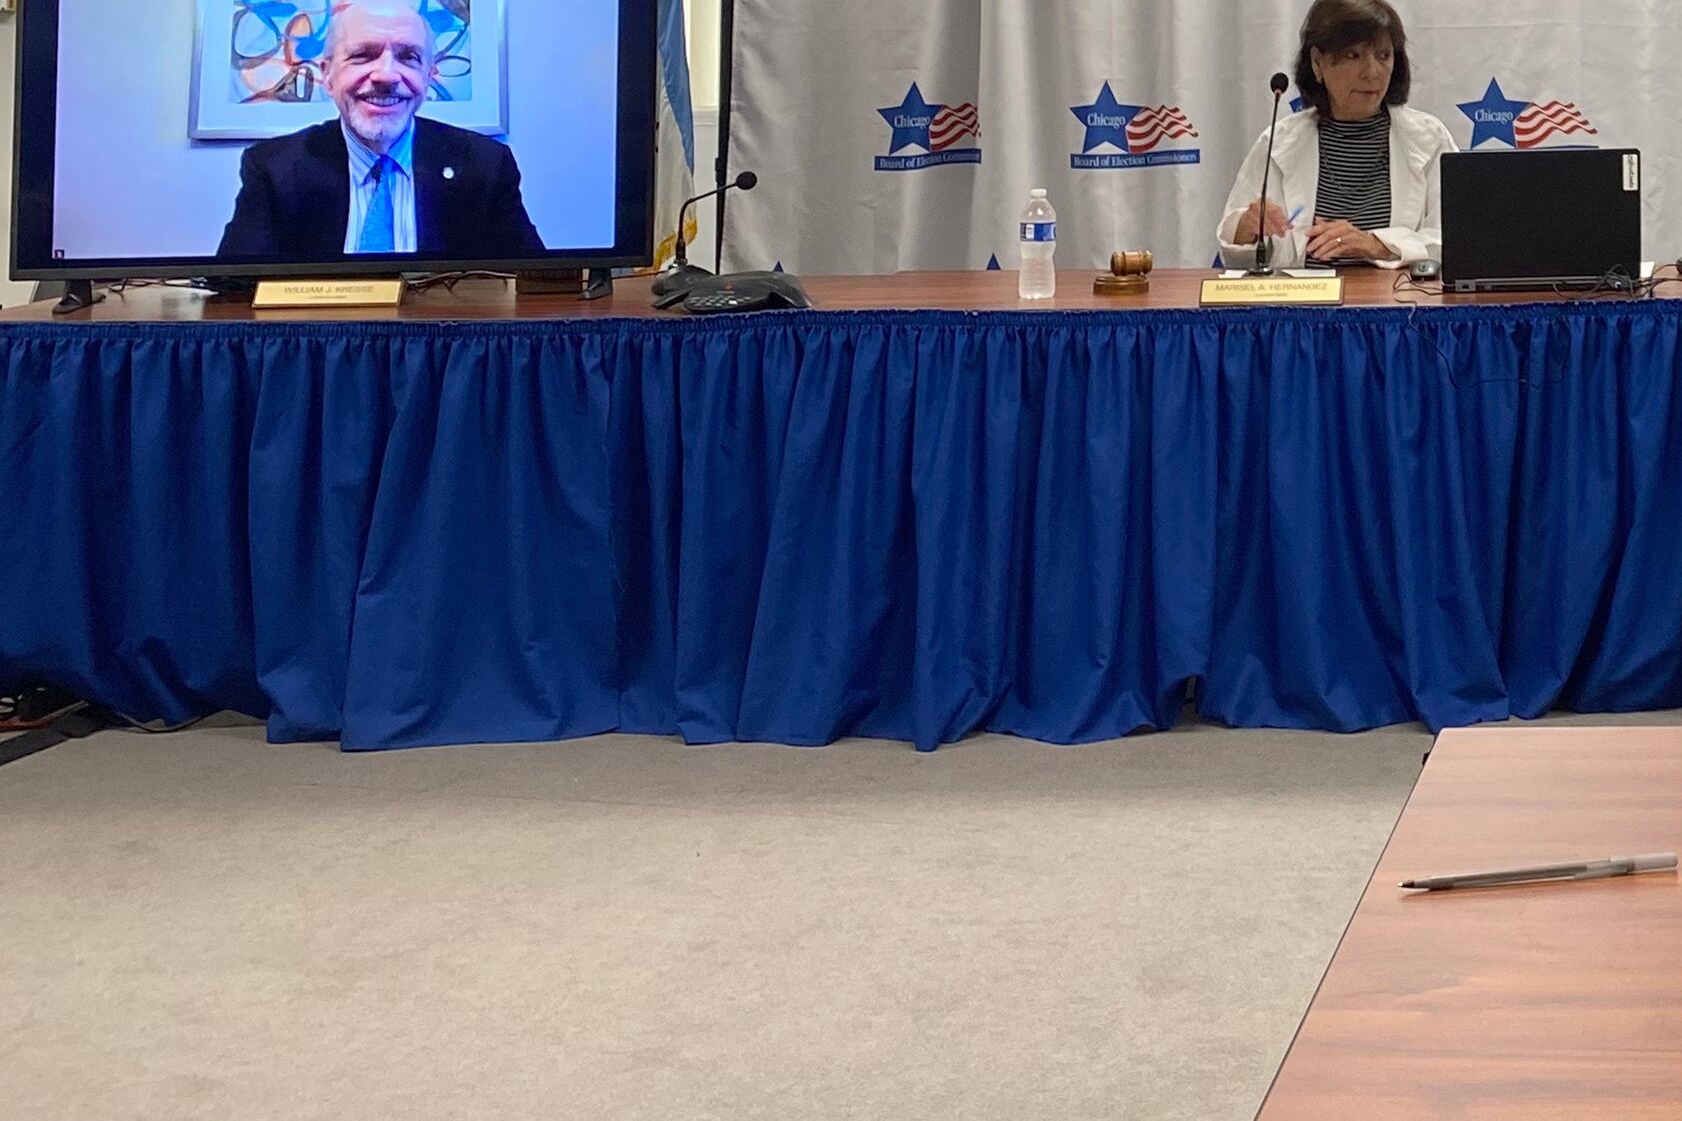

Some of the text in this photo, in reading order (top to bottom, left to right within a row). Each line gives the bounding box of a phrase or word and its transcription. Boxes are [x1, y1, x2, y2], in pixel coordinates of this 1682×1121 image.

[1087, 113, 1126, 129] Chicago
[1474, 109, 1514, 124] Chicago
[894, 116, 930, 130] Chicago
[880, 158, 905, 169] Board
[906, 158, 916, 168] of
[1074, 156, 1099, 166] Board
[1100, 156, 1110, 166] of
[1112, 156, 1146, 166] Election
[1270, 282, 1328, 291] HERNANDEZ
